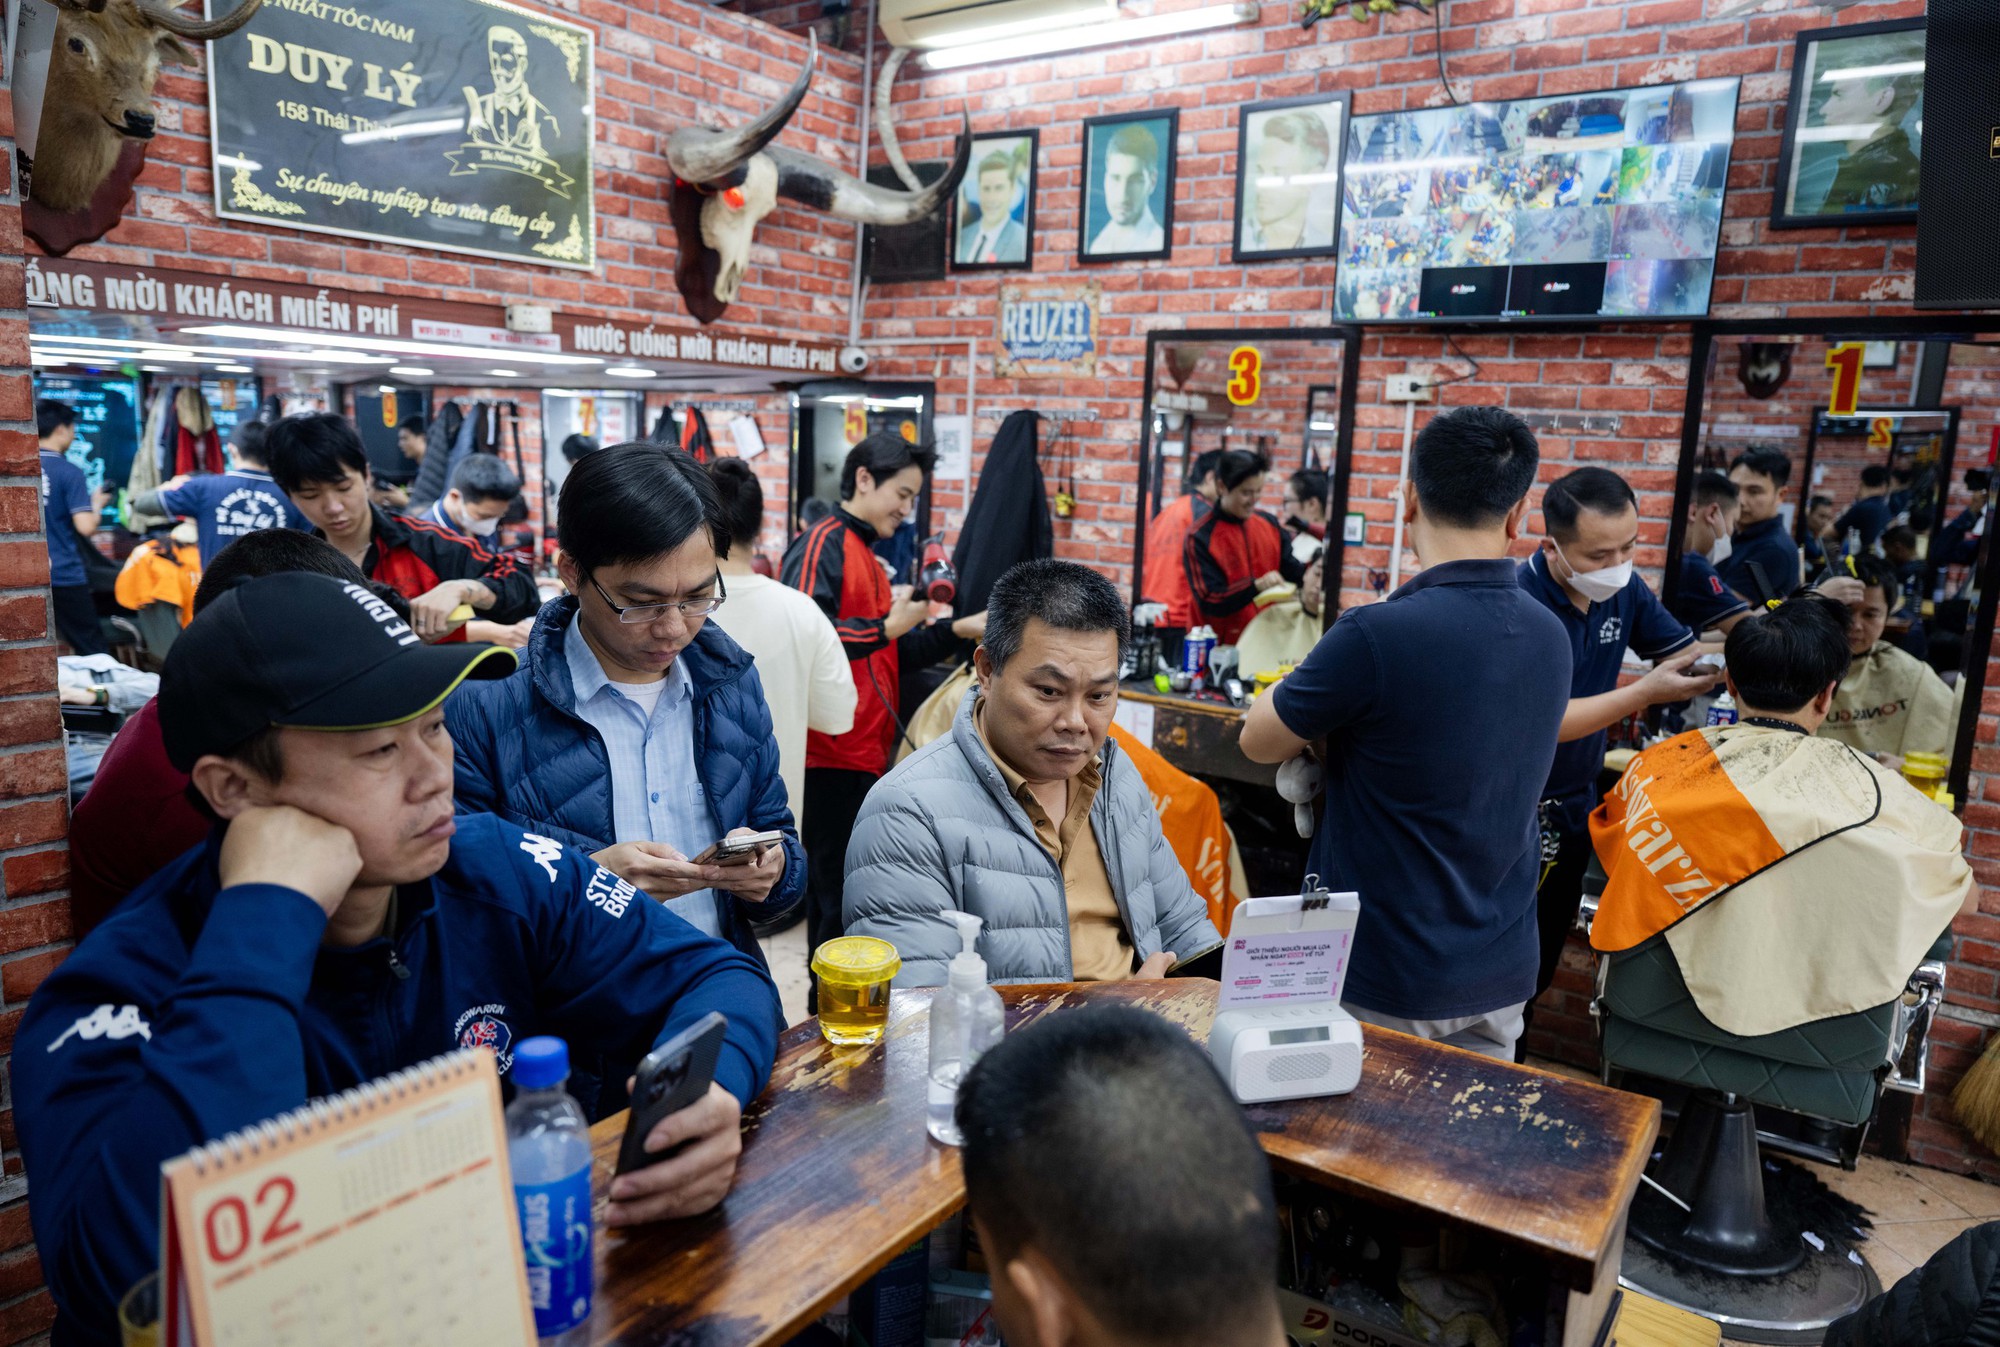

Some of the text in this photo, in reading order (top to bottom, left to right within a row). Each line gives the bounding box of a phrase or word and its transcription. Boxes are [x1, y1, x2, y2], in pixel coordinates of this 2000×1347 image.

[331, 7, 371, 32] TÓC
[371, 18, 415, 44] NAM
[247, 33, 422, 108] DUY LÝ
[276, 99, 309, 122] 158
[312, 106, 350, 131] Thái
[276, 167, 305, 193] Sự
[305, 172, 370, 206] chuyên
[371, 187, 429, 218] nghiệp
[430, 196, 457, 219] tạo
[458, 203, 489, 222] nên
[529, 211, 556, 240] cấp
[104, 272, 168, 312] MỜI
[174, 281, 274, 323] KHÁCH
[280, 289, 351, 332] MIỄN
[356, 303, 399, 336] PHÍ
[1002, 301, 1088, 344] REUZEL
[574, 322, 627, 354] NƯỚC
[629, 323, 678, 359] UỐNG
[680, 331, 713, 362] MỜI
[716, 336, 769, 366] KHÁCH
[808, 346, 837, 373] PHÍ
[1227, 346, 1262, 406] 3
[1826, 341, 1866, 417] 1
[844, 402, 868, 447] 5
[1613, 757, 1730, 914] Schwarz
[454, 1003, 506, 1041] ANGWARRIN
[204, 1174, 303, 1263] 02
